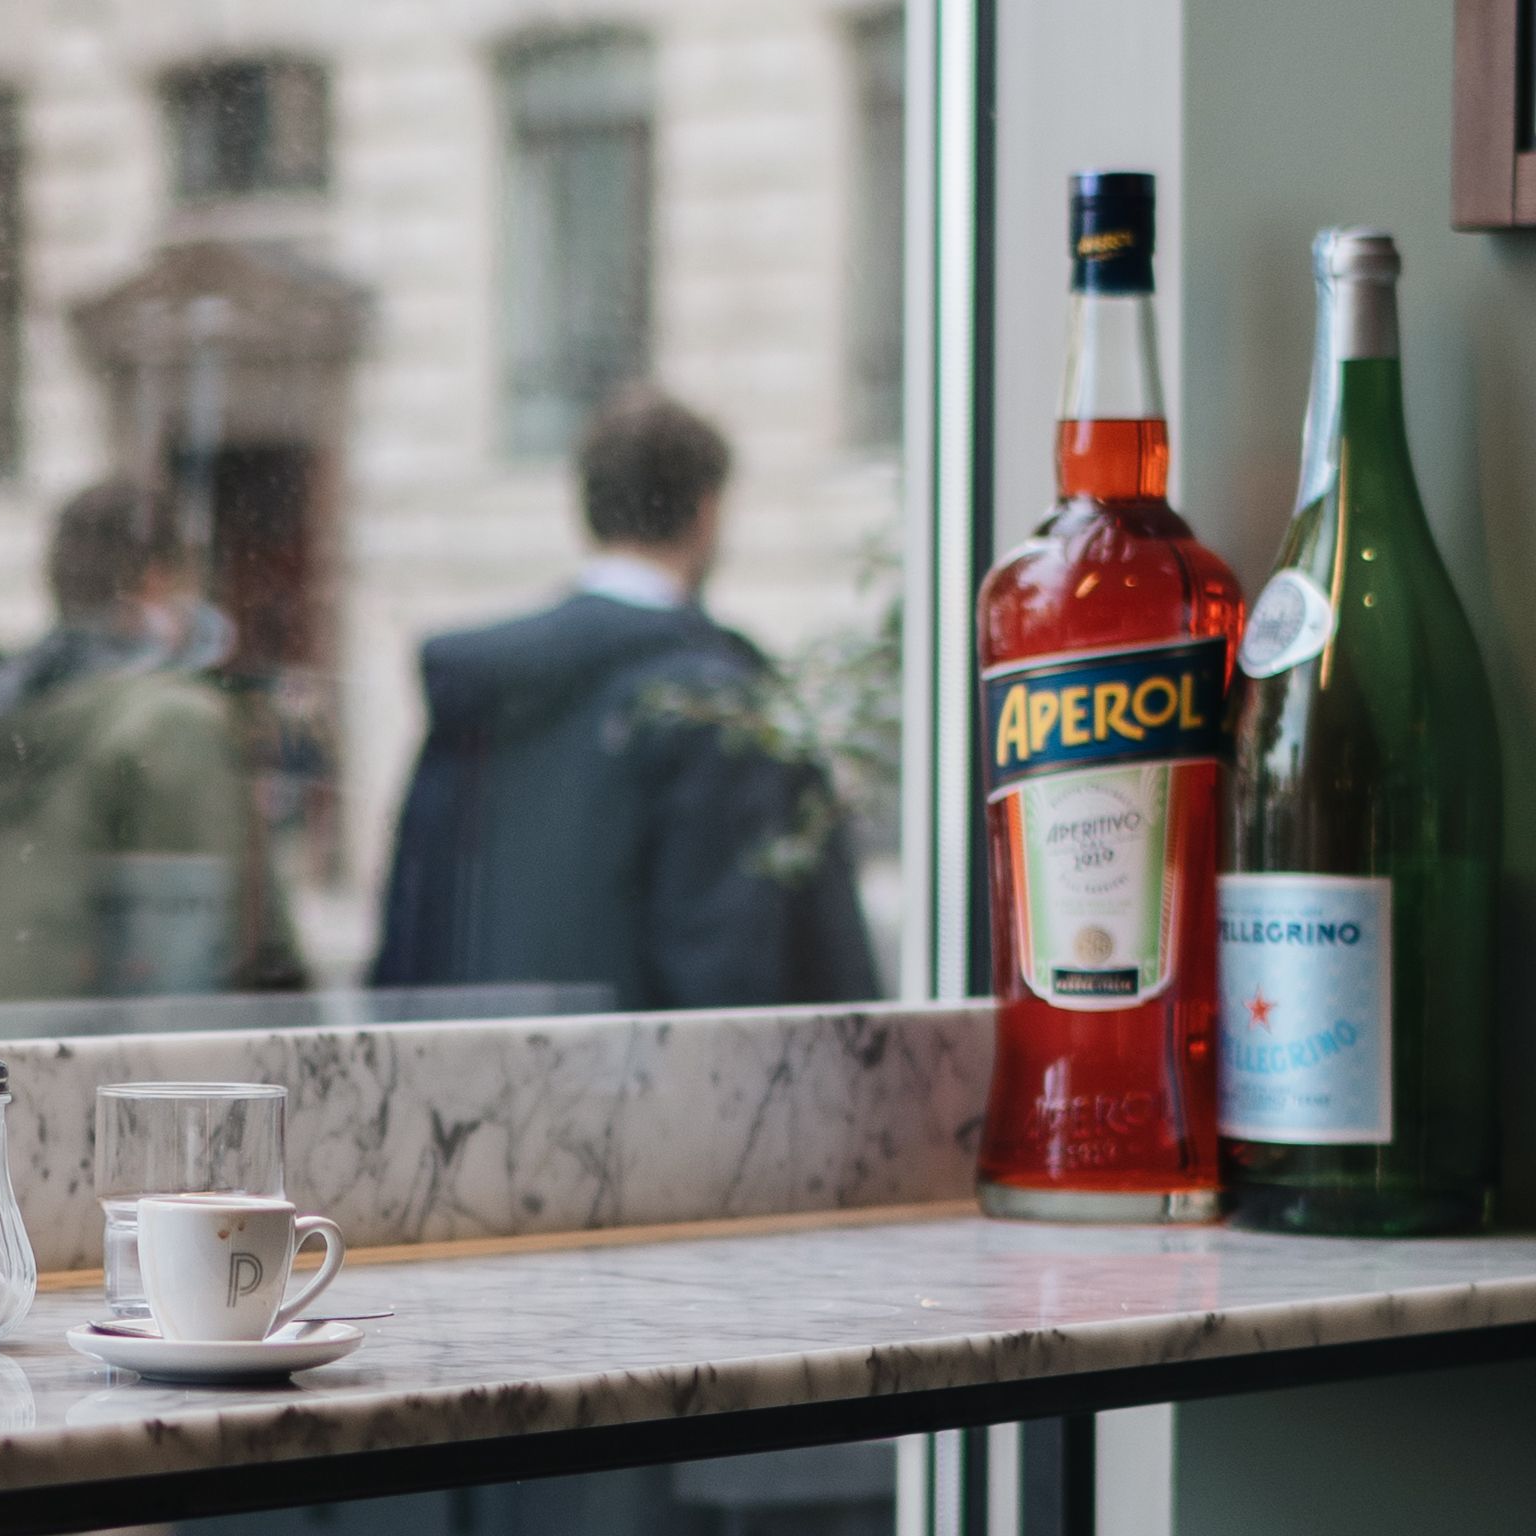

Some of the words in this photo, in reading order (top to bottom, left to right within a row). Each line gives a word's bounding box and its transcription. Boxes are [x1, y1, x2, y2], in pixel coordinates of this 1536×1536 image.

[996, 672, 1205, 768] APEROL
[1046, 812, 1141, 844] APERITIVO
[226, 1252, 263, 1308] P
